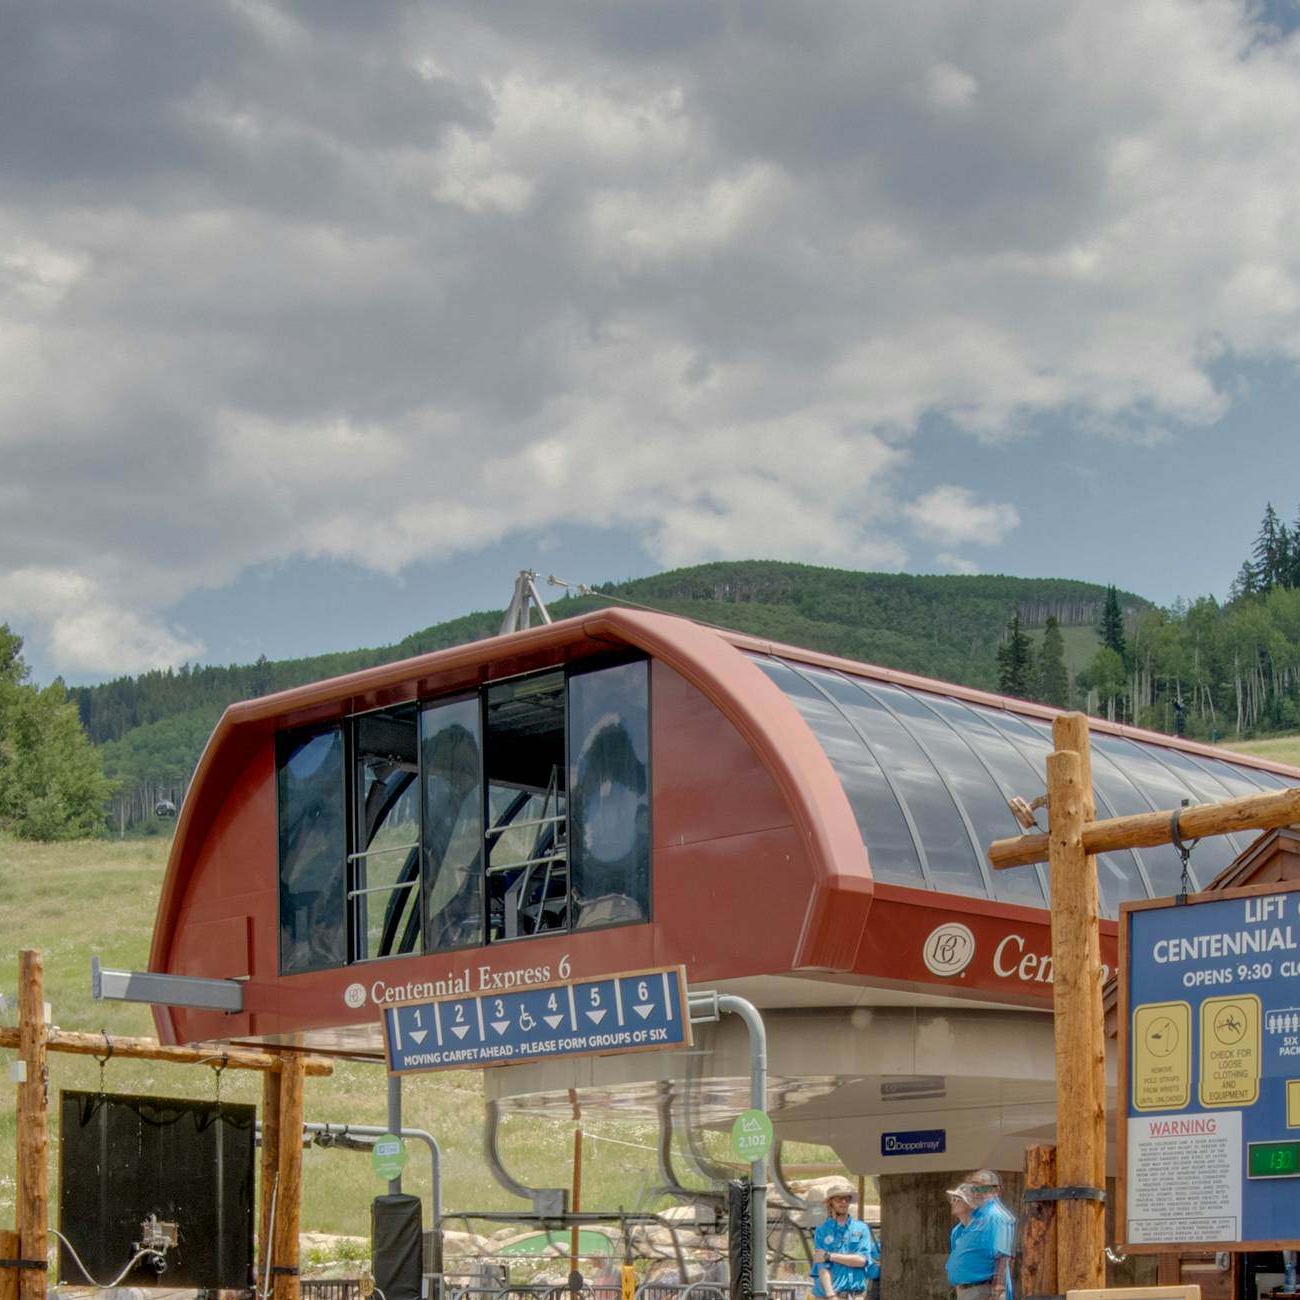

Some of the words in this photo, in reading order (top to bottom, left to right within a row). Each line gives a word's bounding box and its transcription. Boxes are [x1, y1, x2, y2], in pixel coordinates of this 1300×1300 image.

[1245, 896, 1287, 923] LIFT
[1153, 926, 1297, 963] CENTENNIAL
[371, 968, 470, 1004] Centennial
[478, 965, 550, 990] Express
[558, 954, 571, 979] 6
[1183, 967, 1232, 987] OPENS
[1237, 963, 1272, 981] 9:30
[590, 987, 600, 1007] 5
[638, 981, 649, 1001] 6
[495, 999, 504, 1018] 3
[547, 992, 558, 1012] 4
[413, 1009, 422, 1027] 1
[454, 1004, 464, 1023] 2
[404, 1051, 441, 1066] MOVING
[442, 1048, 478, 1061] CARPET
[480, 1046, 513, 1058] AHEAD
[521, 1040, 557, 1053] PLEASE
[559, 1037, 587, 1050] FORM
[588, 1032, 631, 1047] GROUPS
[633, 1030, 648, 1041] OF
[650, 1028, 668, 1040] SIX
[1283, 1036, 1299, 1046] SIX
[1210, 1050, 1234, 1059] CHECK
[1237, 1049, 1252, 1057] FOR
[1218, 1060, 1242, 1069] LOOSE
[1213, 1070, 1248, 1080] CLOTHING
[1209, 1090, 1248, 1100] EQUIPMENT
[1149, 1119, 1217, 1135] WARNING
